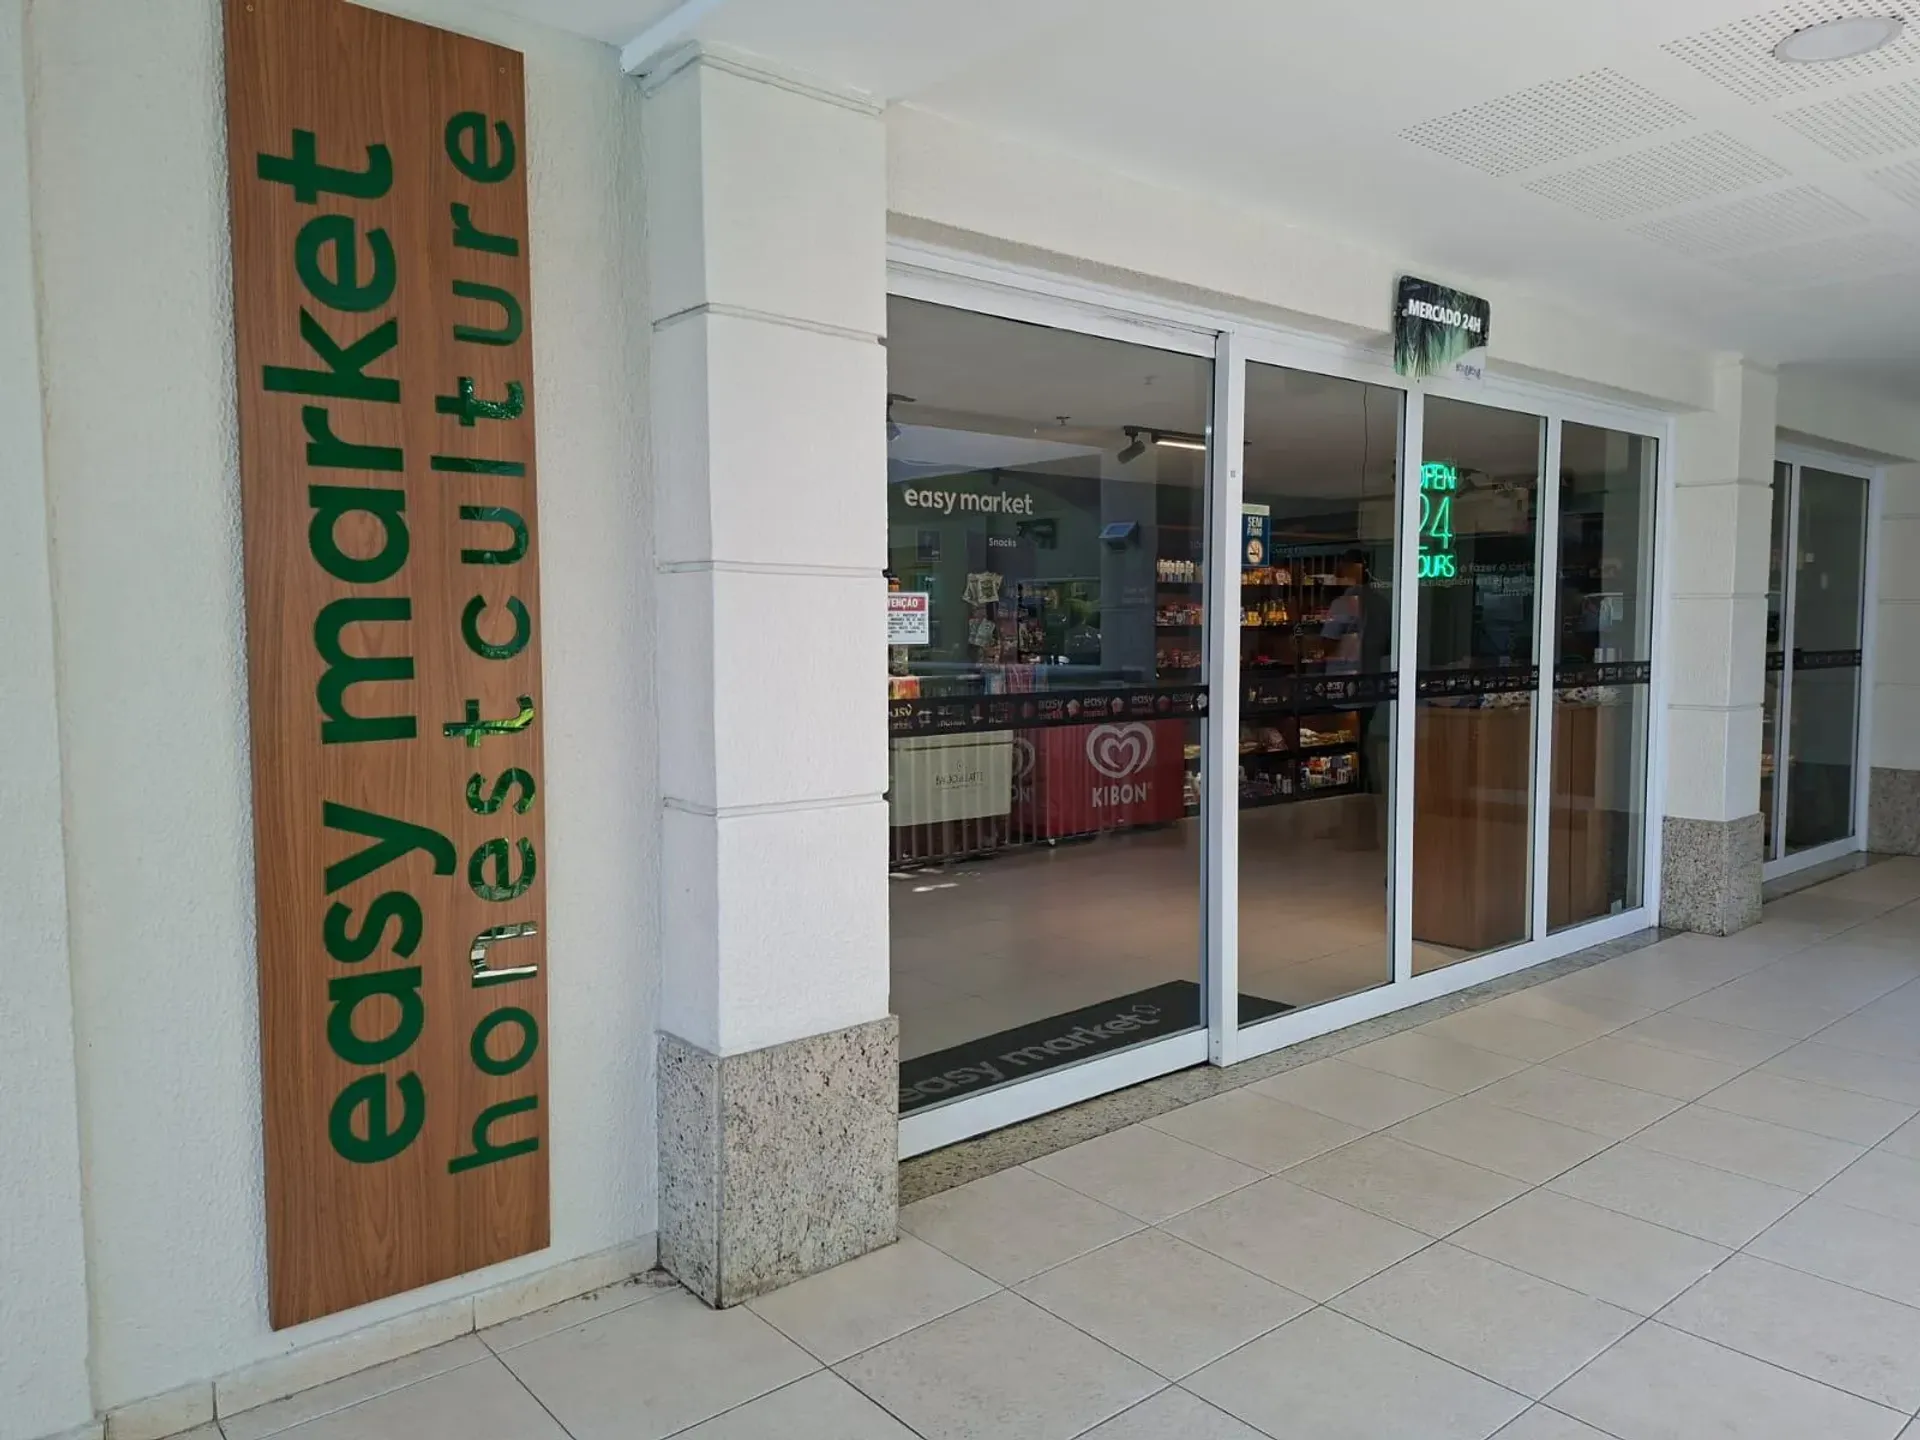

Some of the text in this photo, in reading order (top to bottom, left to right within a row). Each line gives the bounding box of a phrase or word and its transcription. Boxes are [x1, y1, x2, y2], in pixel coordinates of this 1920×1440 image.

[1408, 298, 1481, 333] MERCADO 24H
[904, 488, 1033, 516] easy market
[988, 537, 1017, 549] Snacks
[257, 128, 457, 1164] easy market
[431, 110, 540, 1174] honest culture
[1083, 696, 1109, 708] easy
[1092, 783, 1147, 808] KIBON
[999, 1004, 1161, 1065] market
